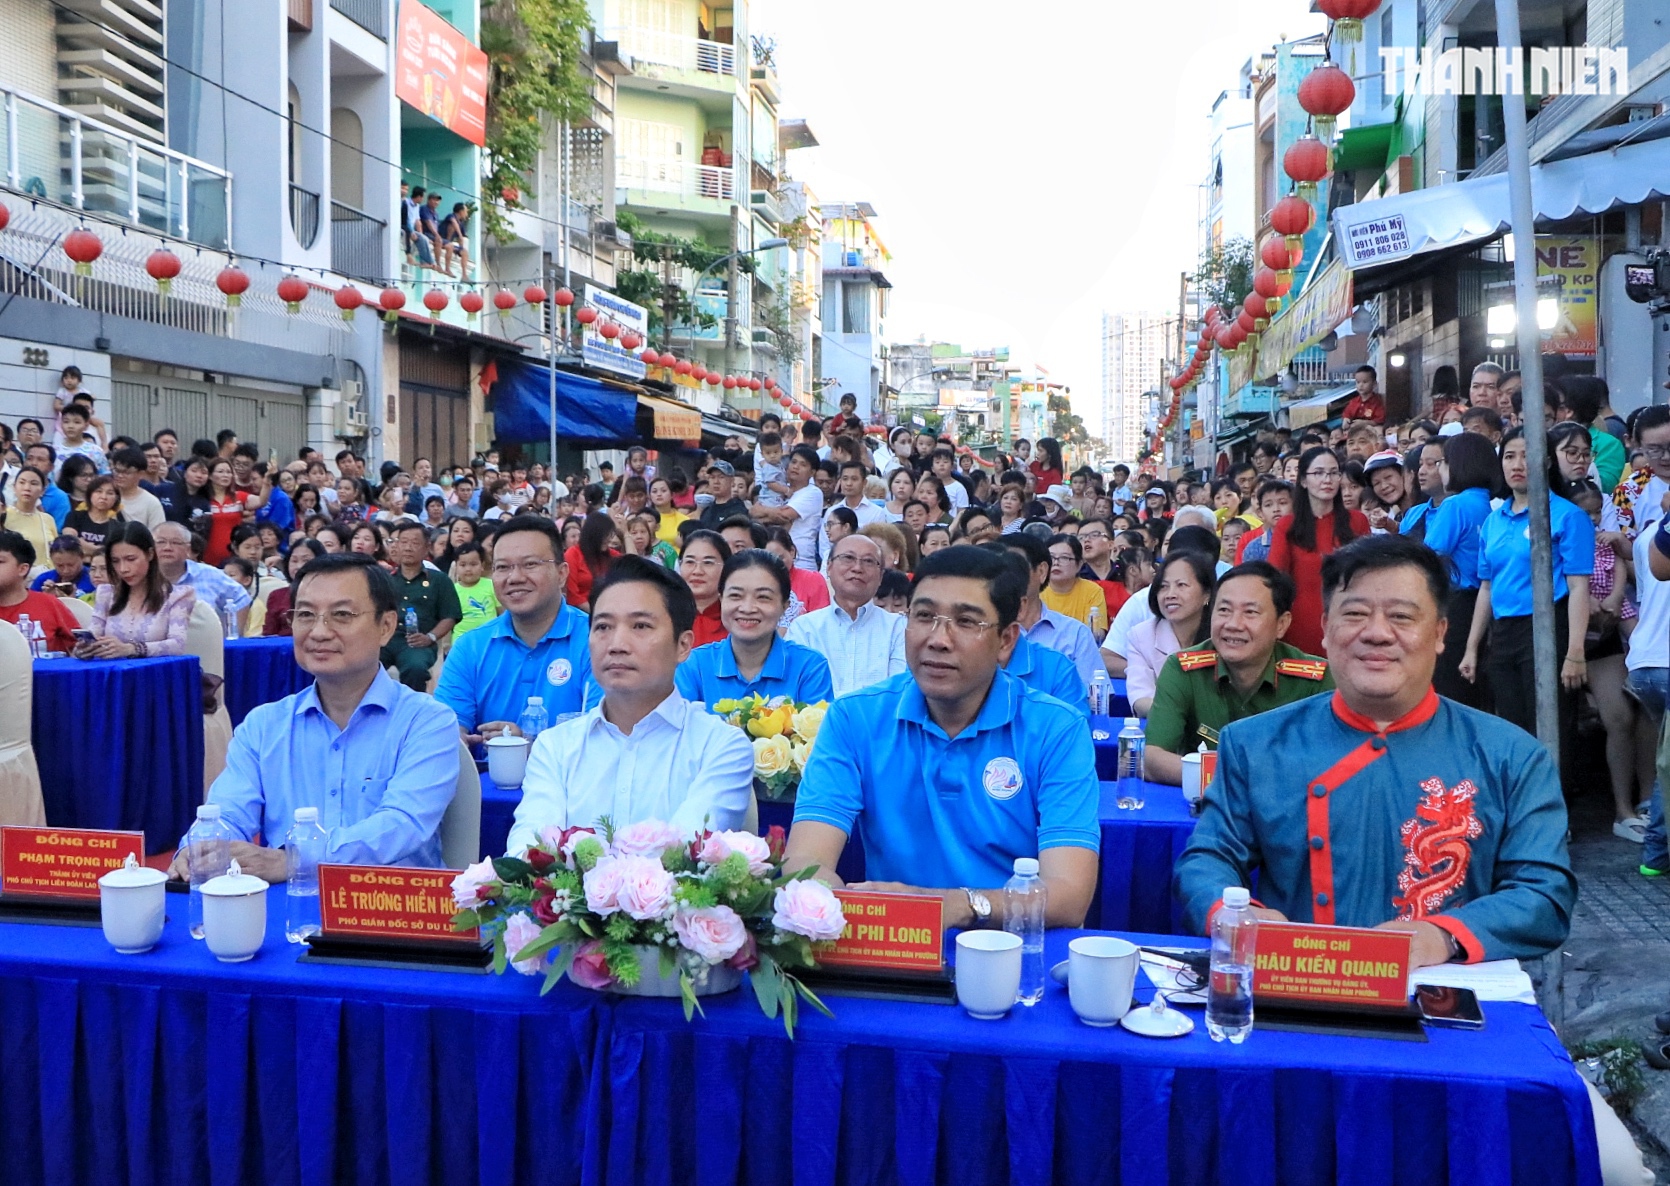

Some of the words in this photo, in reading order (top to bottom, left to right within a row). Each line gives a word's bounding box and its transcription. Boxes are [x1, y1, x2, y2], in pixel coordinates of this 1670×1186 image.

[1355, 238, 1373, 250] 0911
[1375, 235, 1390, 245] 806
[1391, 231, 1405, 242] 028
[1357, 248, 1376, 259] 0908
[1393, 241, 1408, 251] 613
[1536, 239, 1588, 269] NÉ
[1572, 274, 1594, 286] KP
[36, 833, 84, 847] ĐỒNG
[88, 838, 118, 849] CHÍ
[19, 852, 55, 865] PHẠM
[58, 855, 101, 867] TRỌNG
[6, 876, 19, 884] PHÓ
[35, 878, 49, 886] TỊCH
[50, 878, 65, 887] LIÊN
[85, 881, 97, 889] LAO
[350, 872, 404, 886] ĐỒNG
[410, 877, 444, 888] CHÍ
[331, 886, 347, 909] LÊ
[350, 890, 402, 912] TRƯƠNG
[405, 888, 437, 914] HIỀN
[841, 900, 863, 915] ỒNG
[867, 904, 886, 917] CHÍ
[338, 917, 358, 926] PHÓ
[361, 917, 385, 927] GIÁM
[388, 918, 408, 929] ĐỐC
[411, 920, 424, 930] SỞ
[427, 922, 440, 931] DU
[857, 924, 884, 942] PHI
[889, 926, 932, 945] LONG
[1293, 935, 1327, 950] ĐỒNG
[1330, 939, 1351, 952] CHÍ
[872, 949, 883, 957] BAN
[1296, 952, 1336, 975] KIẾN
[1341, 960, 1399, 978] QUANG
[1295, 976, 1308, 985] BAN
[1309, 986, 1322, 994] BAN
[1323, 985, 1340, 995] NHÂN
